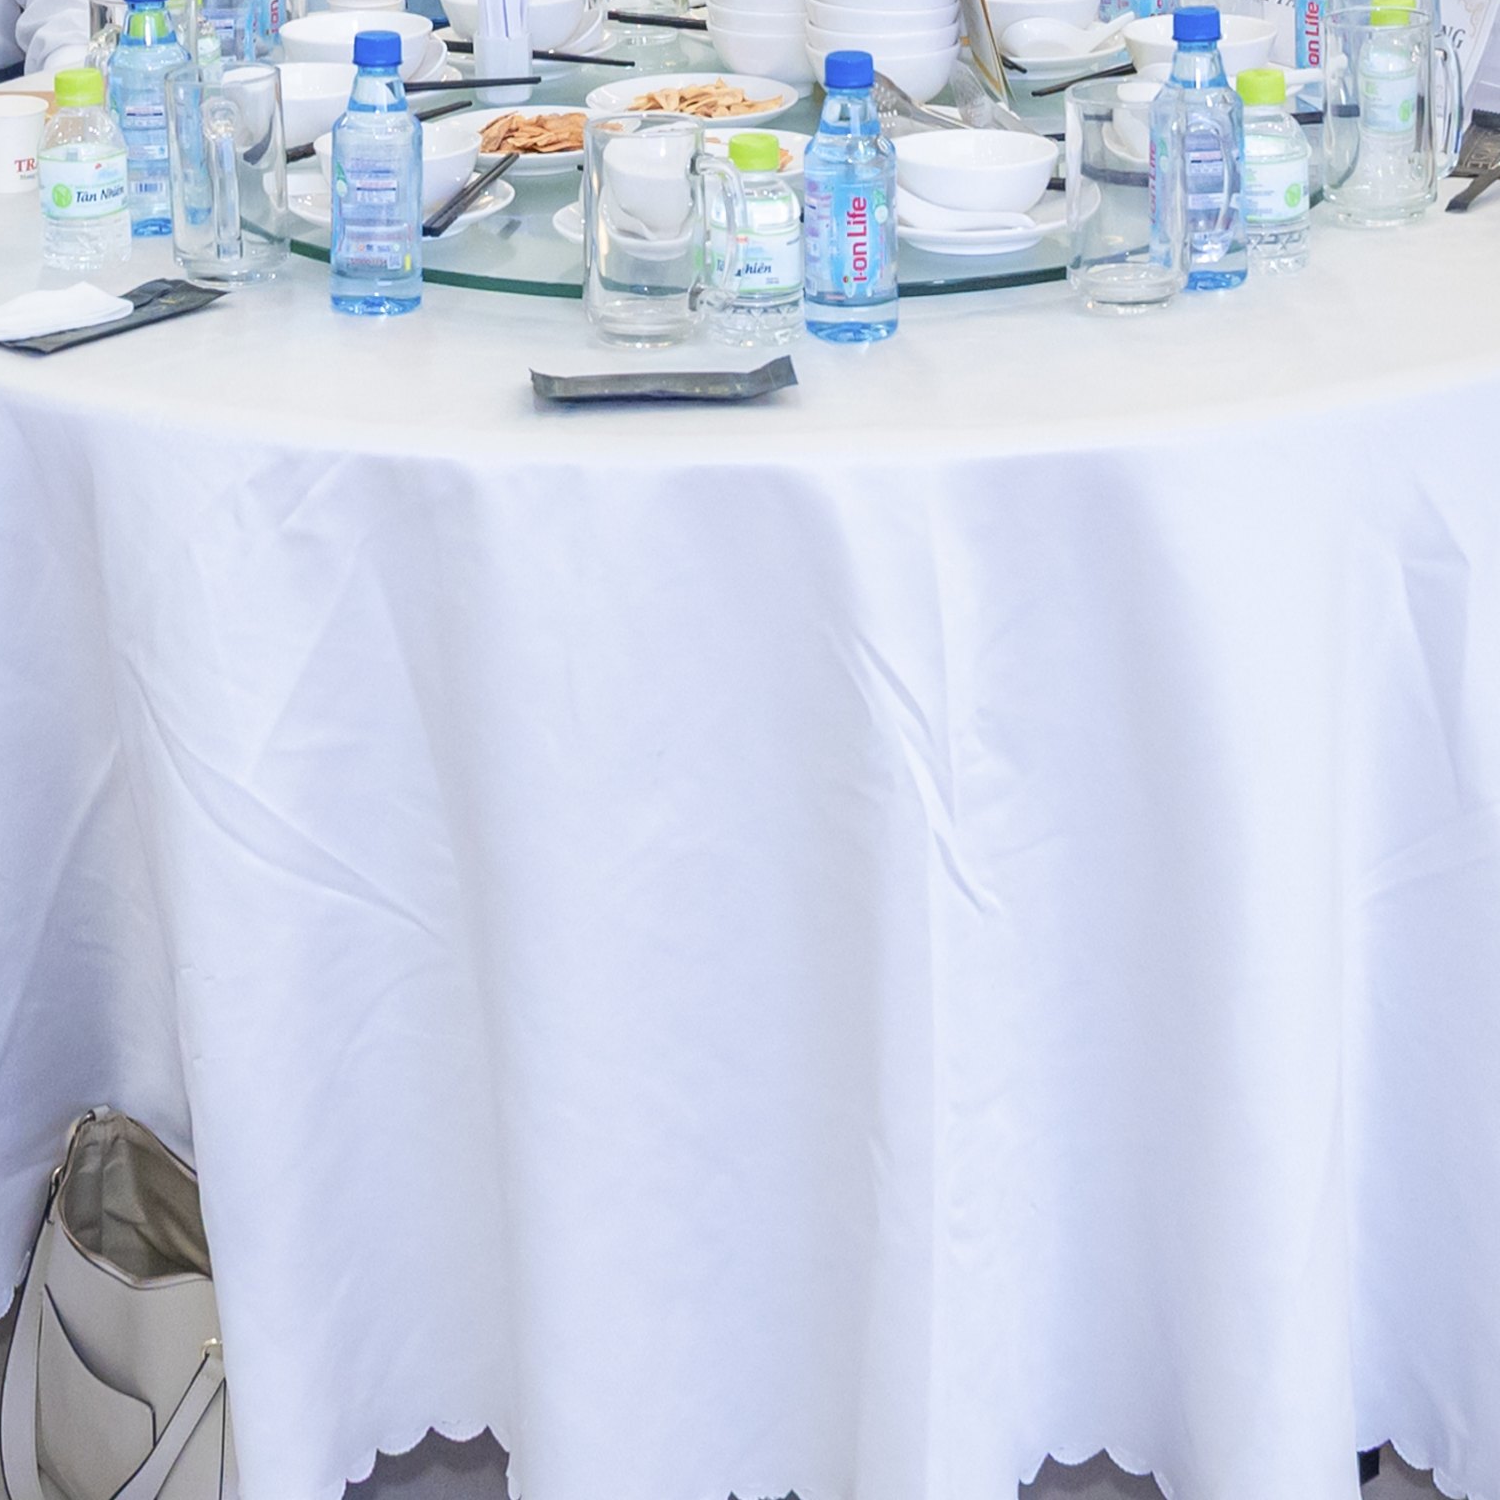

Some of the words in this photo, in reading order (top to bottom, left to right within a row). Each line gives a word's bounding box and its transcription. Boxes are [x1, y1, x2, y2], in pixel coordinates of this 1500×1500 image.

[1304, 1, 1320, 34] Life
[1307, 35, 1320, 67] on
[14, 157, 37, 173] TR
[76, 191, 98, 203] Tân
[847, 196, 868, 238] Life
[852, 242, 868, 283] I-on
